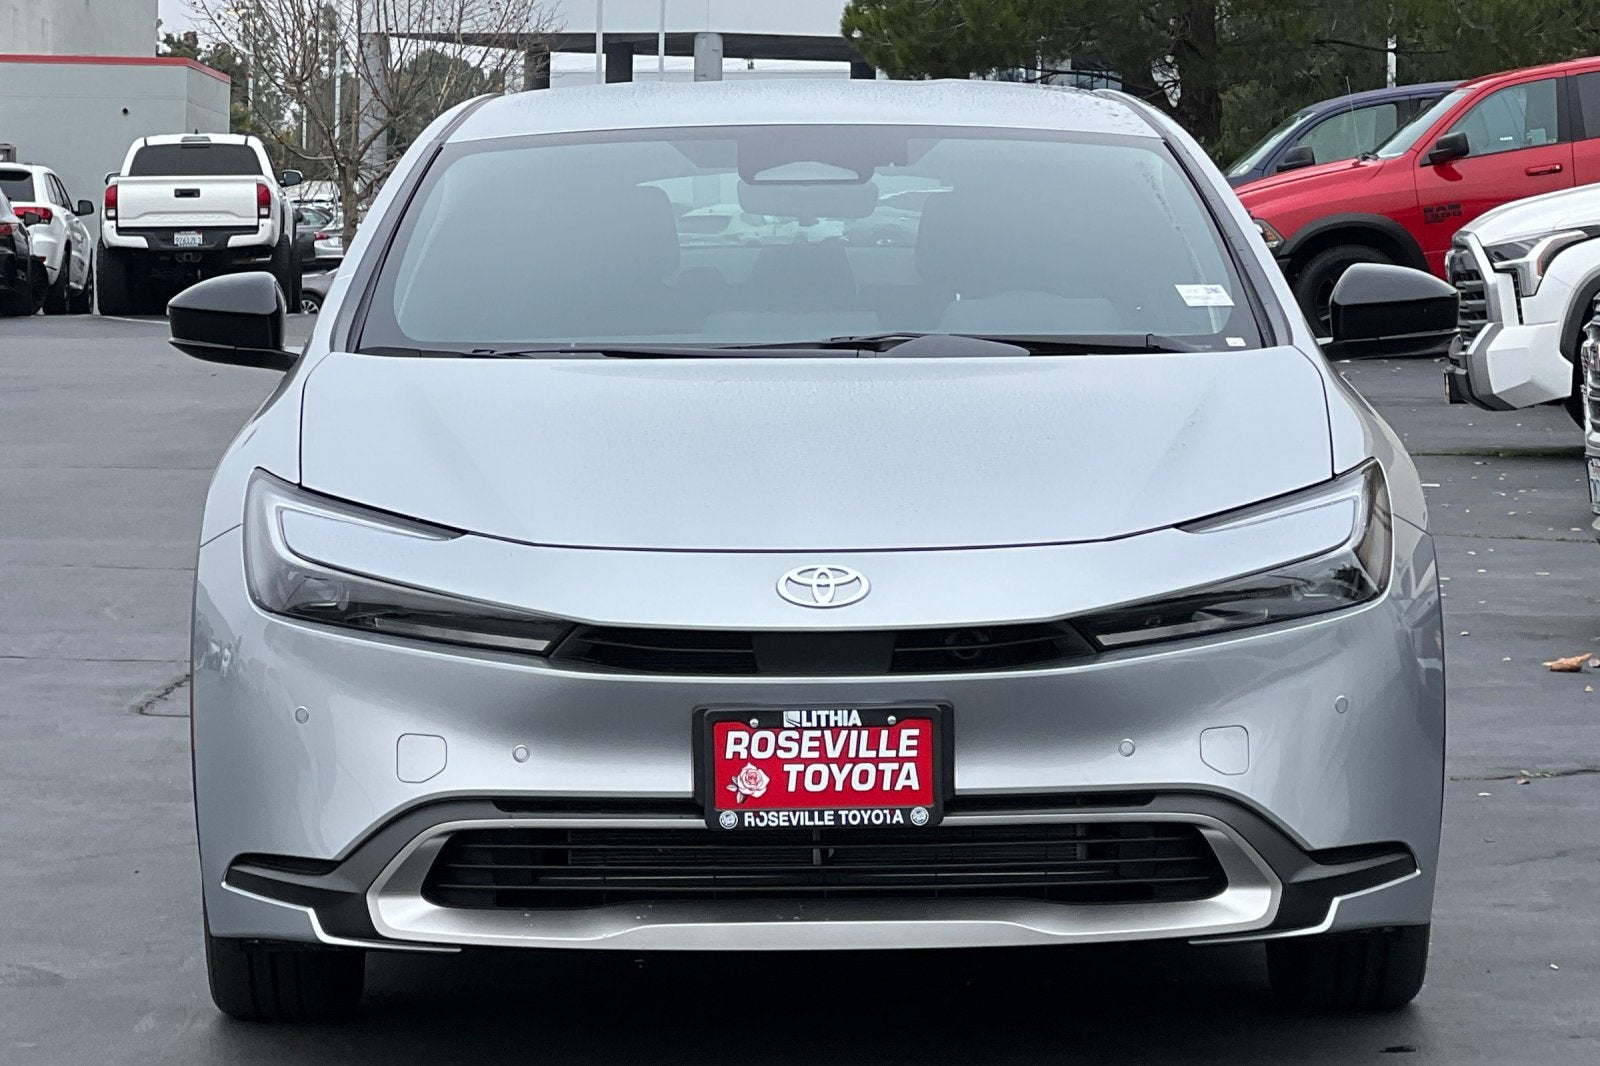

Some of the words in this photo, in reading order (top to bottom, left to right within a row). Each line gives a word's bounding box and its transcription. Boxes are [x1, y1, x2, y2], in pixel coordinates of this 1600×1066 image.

[801, 709, 863, 727] LITHIA
[725, 728, 920, 760] ROSEVILLE
[783, 762, 920, 792] TOYOTA
[744, 810, 835, 827] ROSEVILLE
[838, 808, 904, 825] TOYOTA
